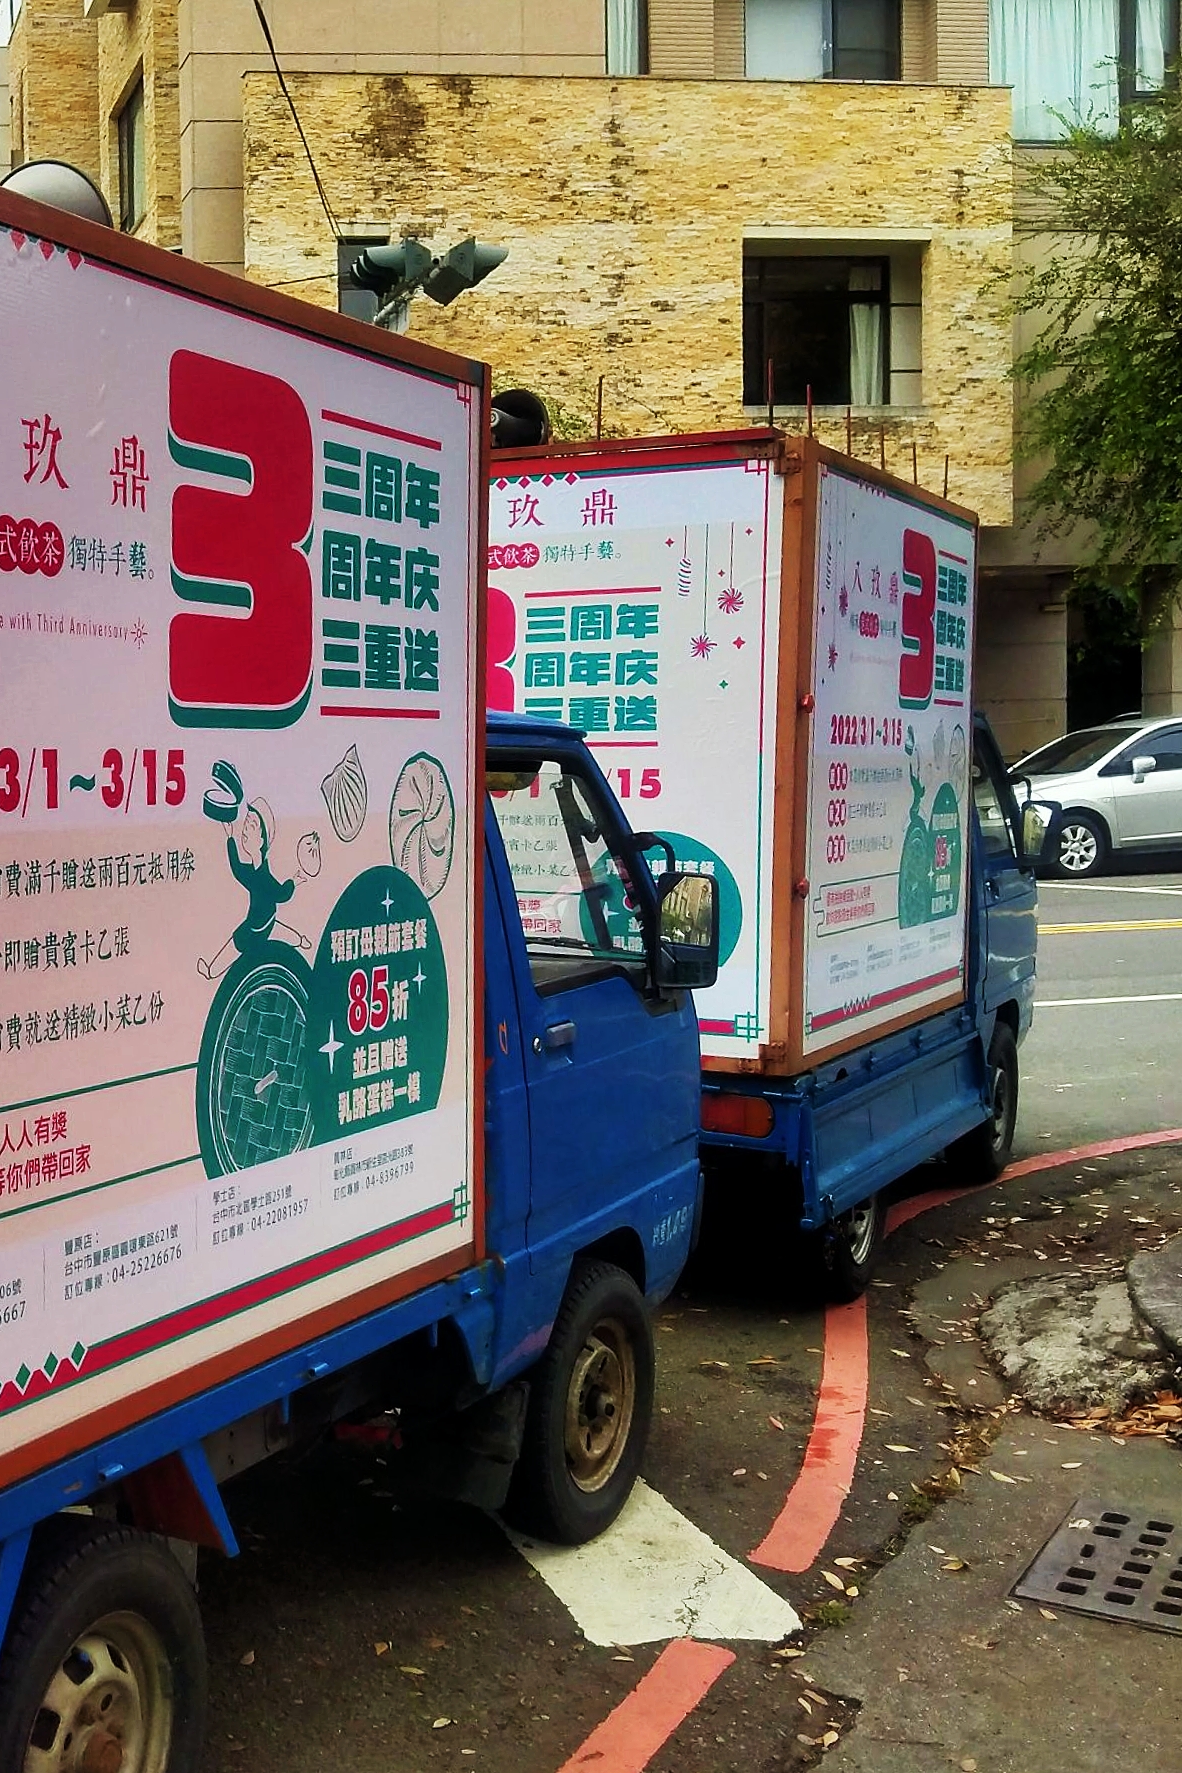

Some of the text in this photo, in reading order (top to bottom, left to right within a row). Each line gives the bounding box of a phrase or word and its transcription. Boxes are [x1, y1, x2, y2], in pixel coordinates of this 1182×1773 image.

[321, 439, 440, 530] 三周年
[168, 348, 315, 729] 3
[322, 528, 440, 614] 周年庆
[9, 611, 32, 631] with
[37, 613, 65, 634] Third
[69, 618, 129, 640] Anniversary
[322, 618, 440, 692] 三重送
[525, 603, 659, 643] 三周年
[899, 528, 937, 710] 3
[524, 650, 659, 688] 周年庆
